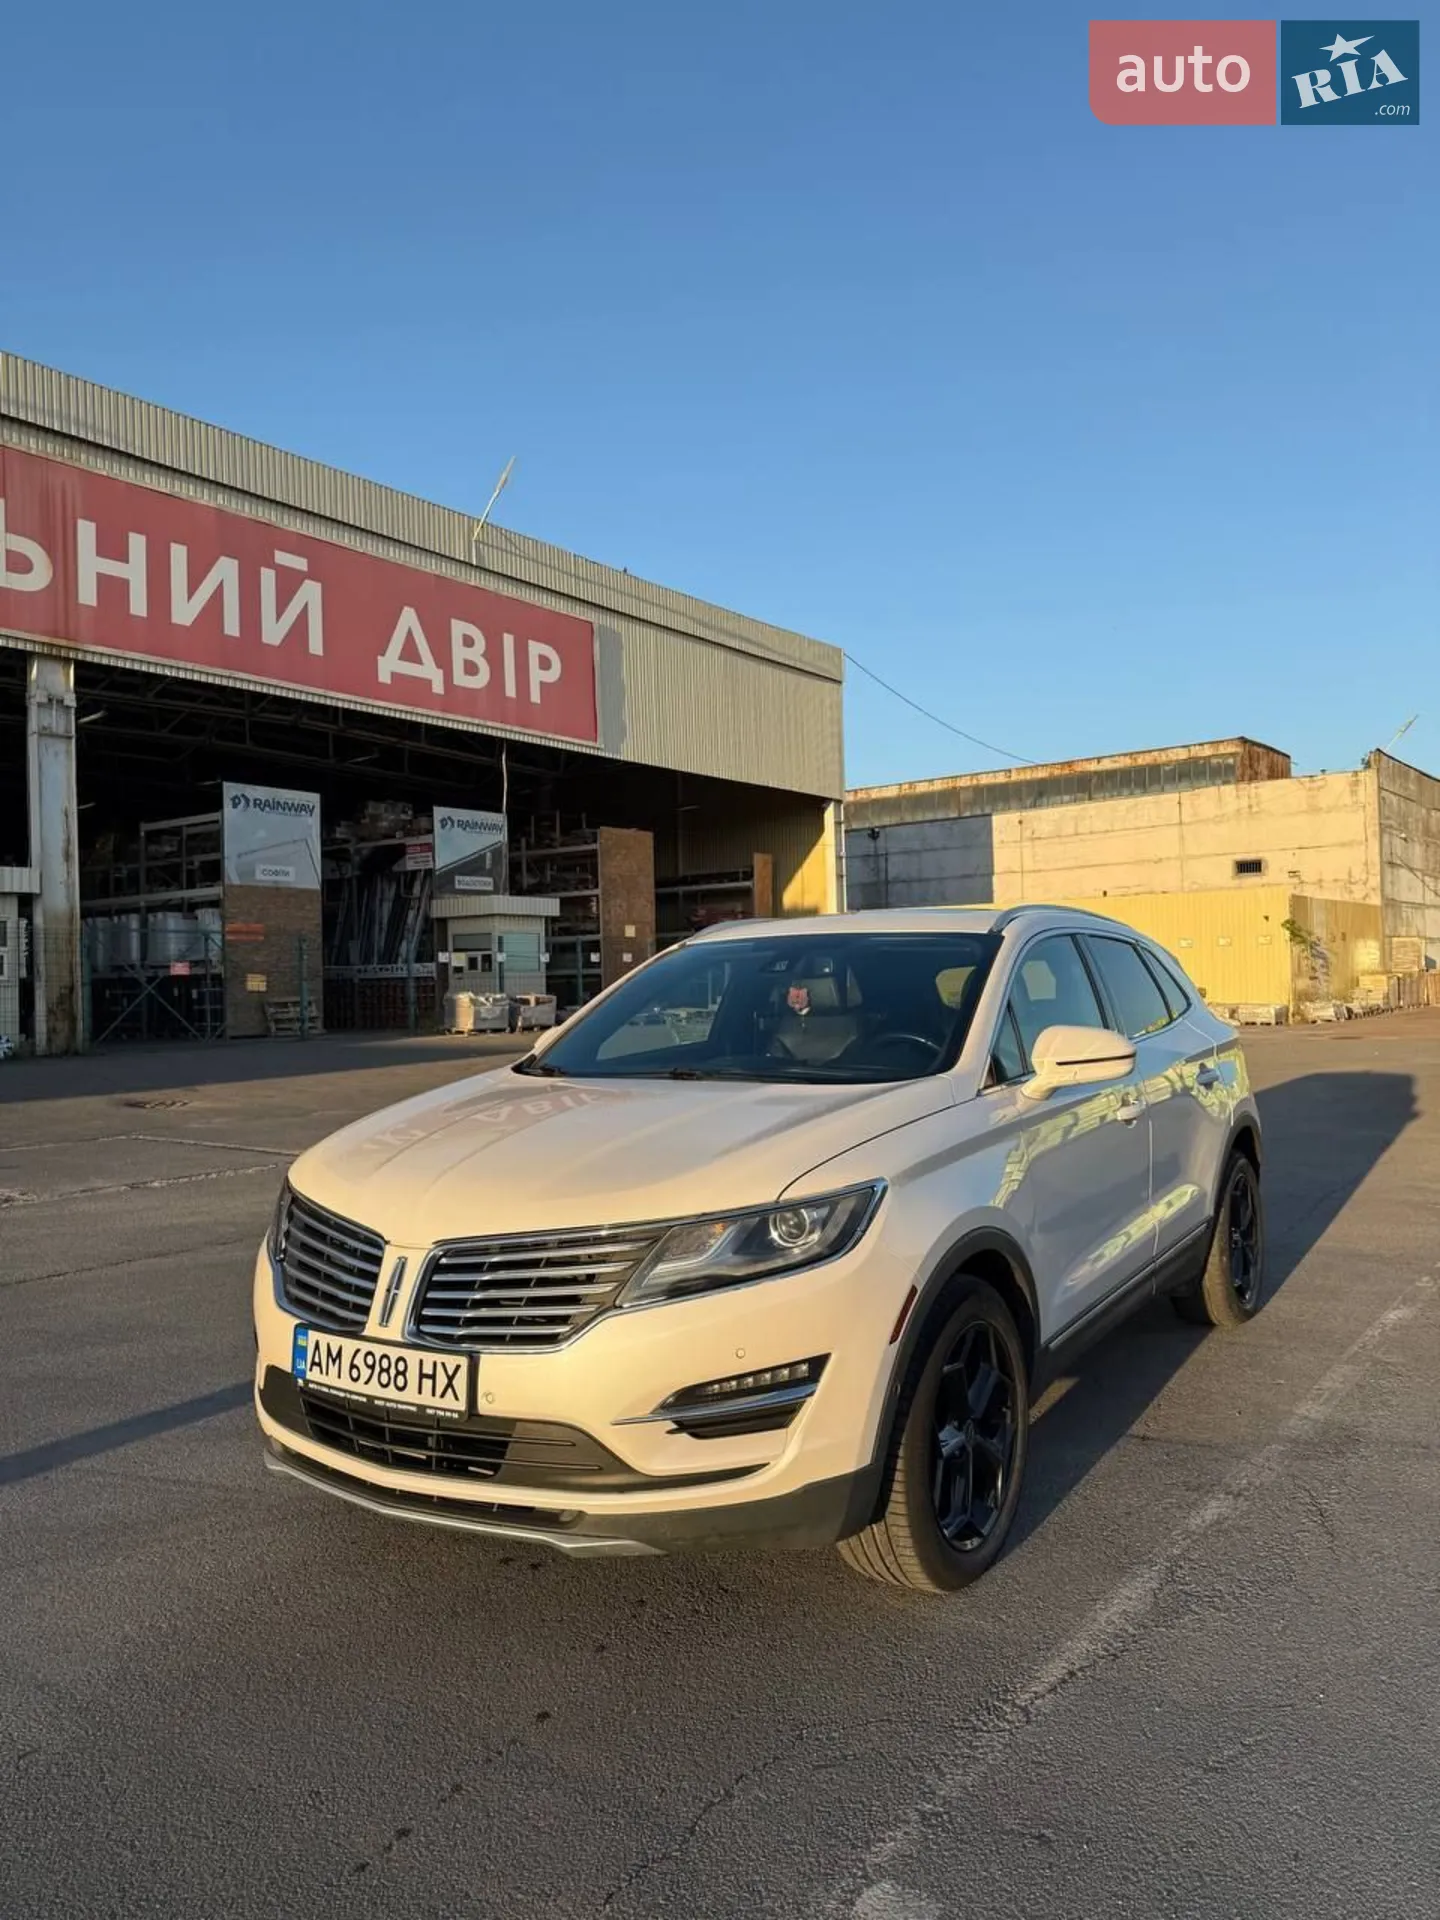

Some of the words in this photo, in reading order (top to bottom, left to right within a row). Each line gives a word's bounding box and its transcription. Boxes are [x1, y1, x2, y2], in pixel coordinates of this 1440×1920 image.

[377, 605, 563, 705] ДВІР
[253, 797, 316, 817] RAINWAY
[457, 818, 504, 834] RAINWAY
[308, 1339, 343, 1379] AM
[348, 1348, 409, 1392] 6988
[417, 1358, 462, 1402] HX
